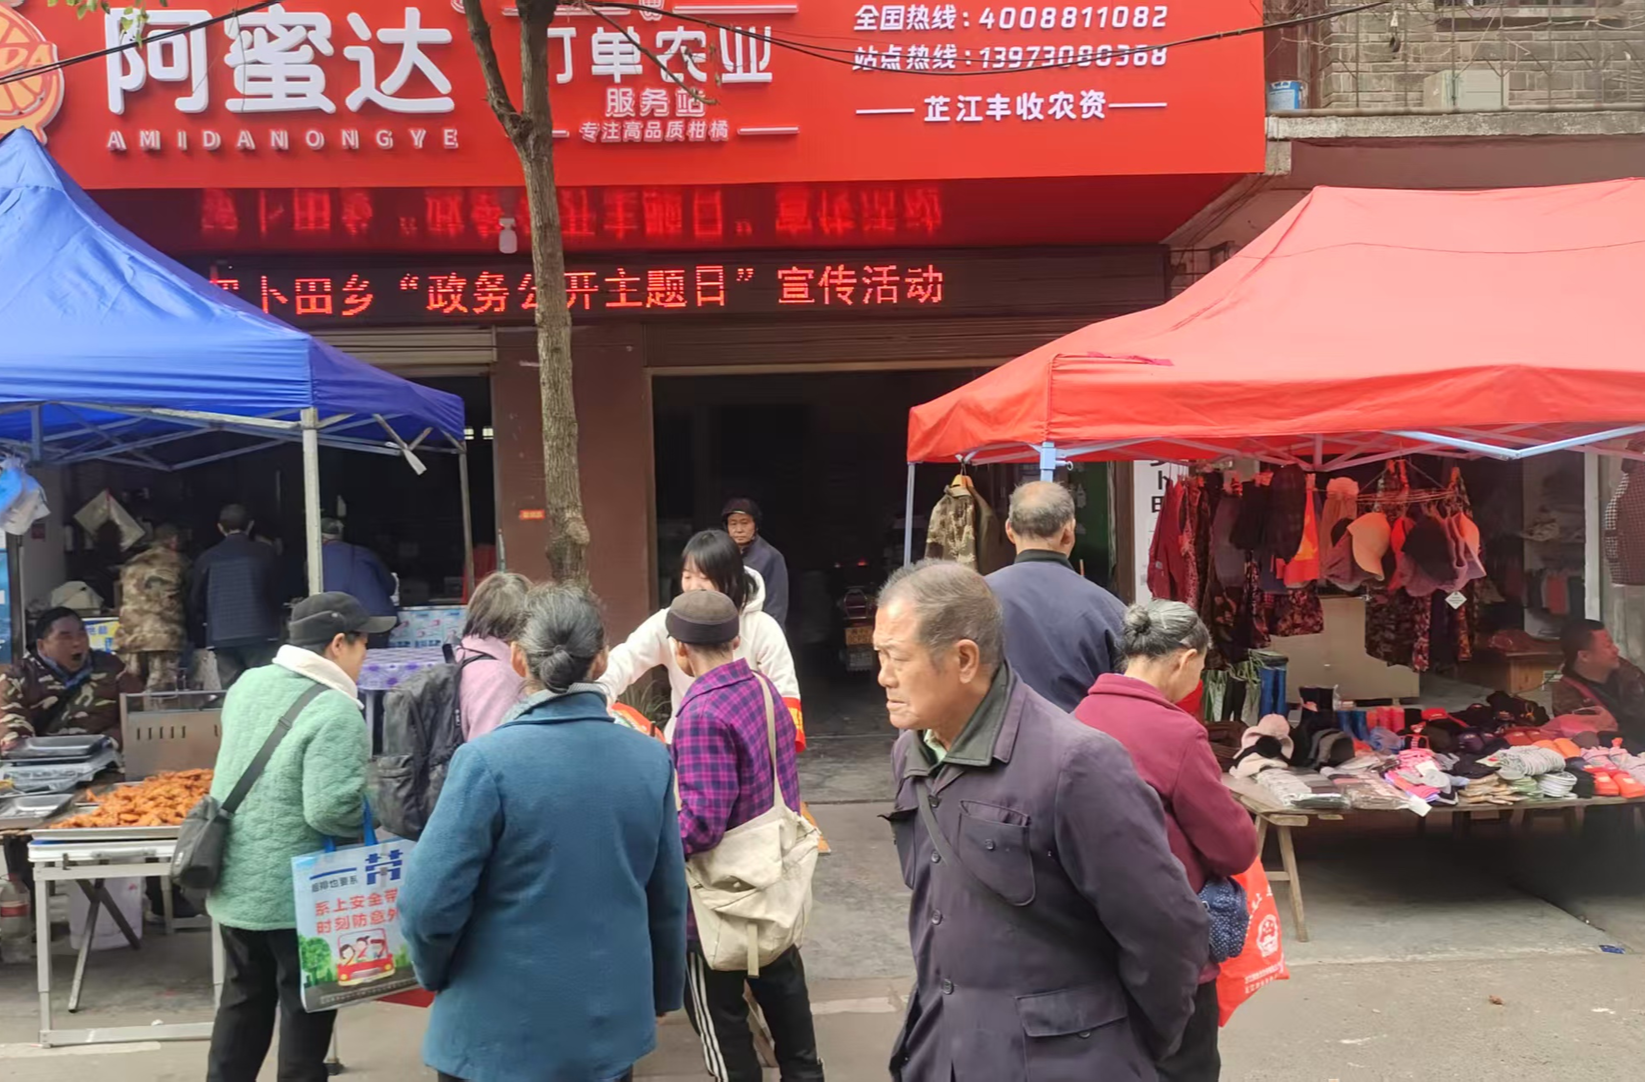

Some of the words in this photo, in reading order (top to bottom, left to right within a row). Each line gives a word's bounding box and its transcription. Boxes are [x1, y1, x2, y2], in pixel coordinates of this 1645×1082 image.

[104, 4, 455, 115] 阿蜜达
[606, 88, 706, 117] 服务站
[924, 90, 1106, 123] 芷江丰收农资
[106, 130, 459, 150] AMIDANONGYE
[579, 120, 730, 143] 专注高品质柑橘
